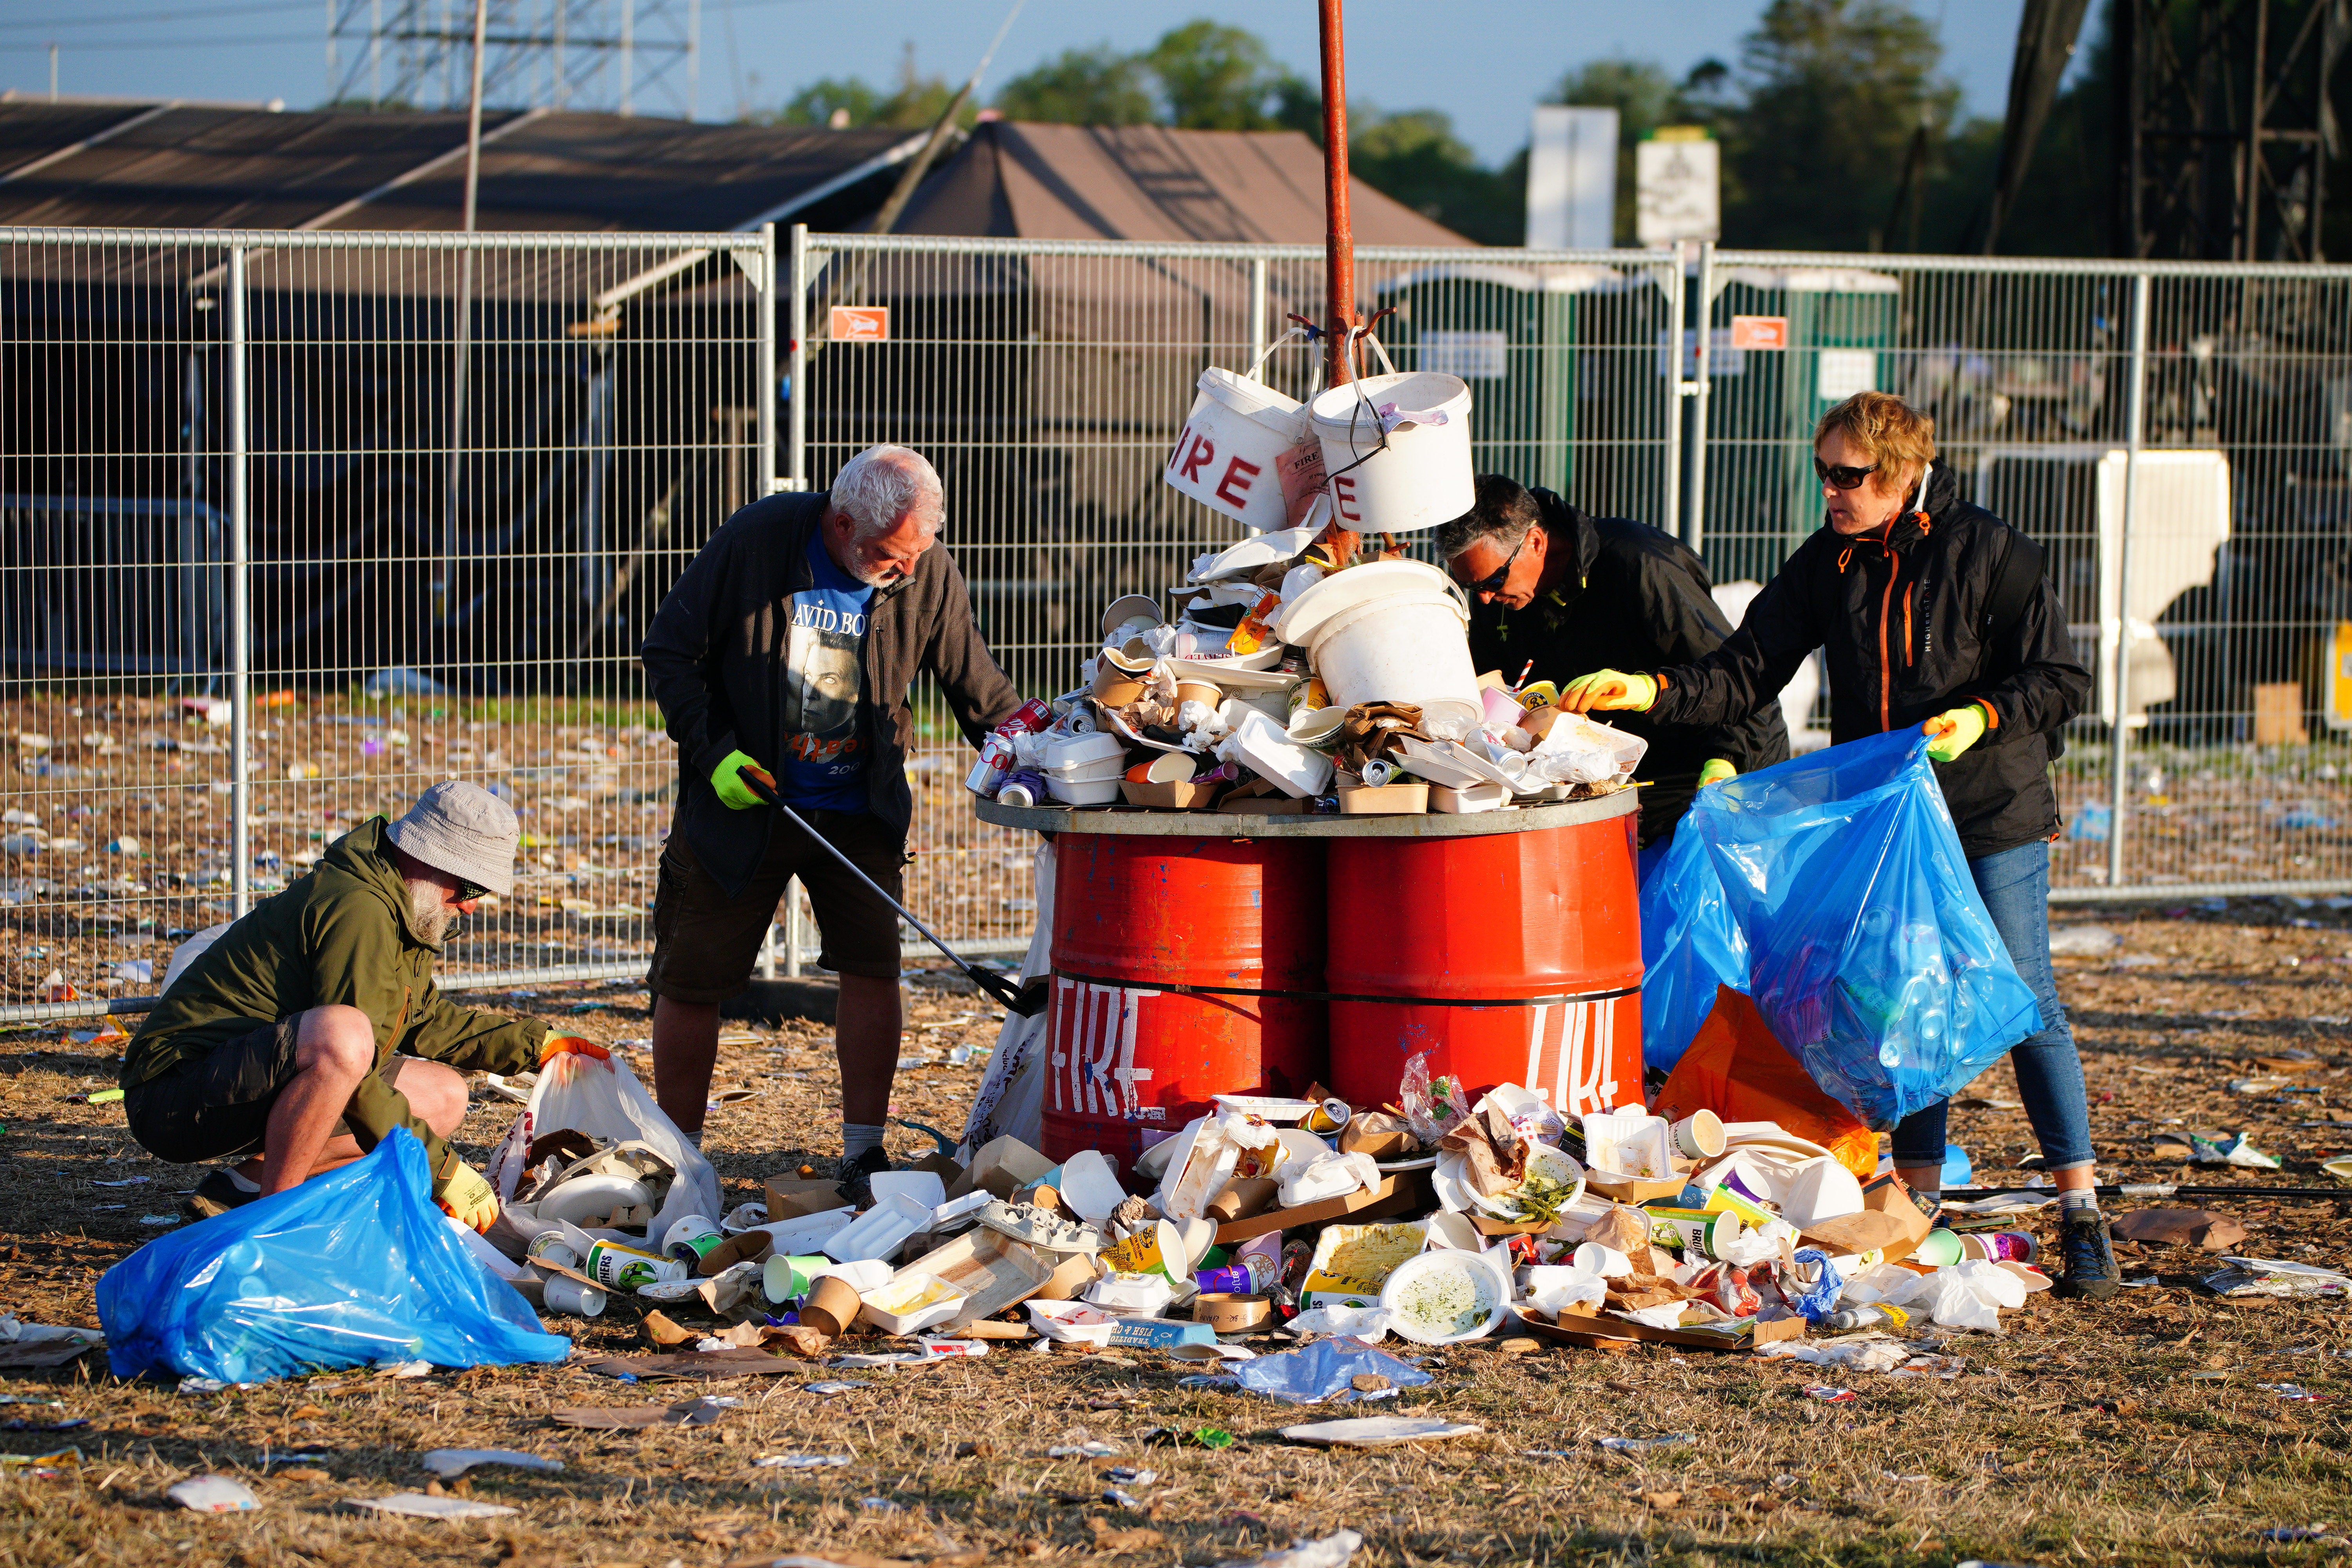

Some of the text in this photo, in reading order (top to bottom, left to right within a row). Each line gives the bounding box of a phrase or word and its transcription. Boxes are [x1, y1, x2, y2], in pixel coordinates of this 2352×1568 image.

[1294, 452, 1319, 470] FIRE
[1334, 477, 1361, 521] E
[791, 602, 870, 637] AVID BO
[1051, 976, 1166, 1120] FIRE
[1232, 1271, 1242, 1294] enjo
[1124, 1325, 1131, 1333] &
[1131, 1326, 1154, 1337] FISH
